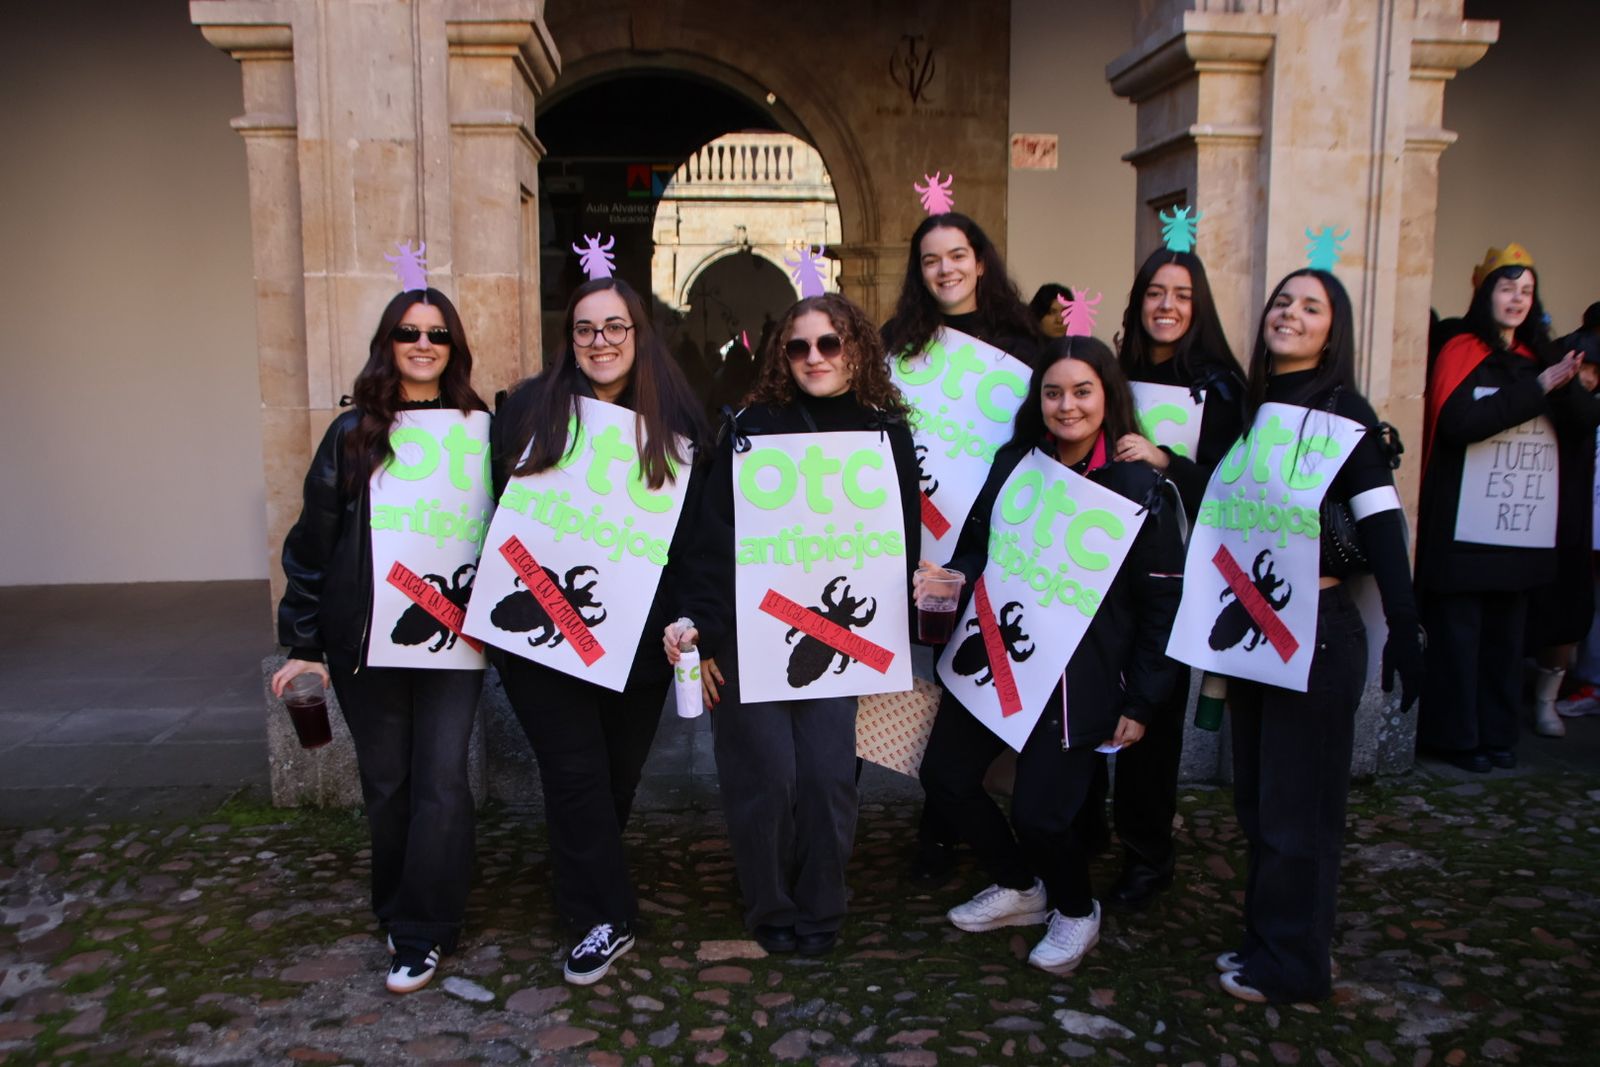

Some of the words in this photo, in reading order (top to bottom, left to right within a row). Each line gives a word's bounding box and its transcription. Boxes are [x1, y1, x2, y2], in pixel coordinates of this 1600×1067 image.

[586, 202, 609, 214] Aula
[896, 338, 1027, 423] otc
[384, 424, 494, 498] ot
[739, 445, 888, 514] otc
[1220, 415, 1341, 490] otc
[1485, 472, 1517, 498] ES
[1523, 474, 1545, 500] EL
[499, 483, 669, 566] antipiojos
[1001, 469, 1125, 571] otc
[1495, 502, 1537, 532] REY
[736, 522, 904, 573] antipiojos
[547, 594, 565, 611] 2
[830, 627, 842, 642] 2
